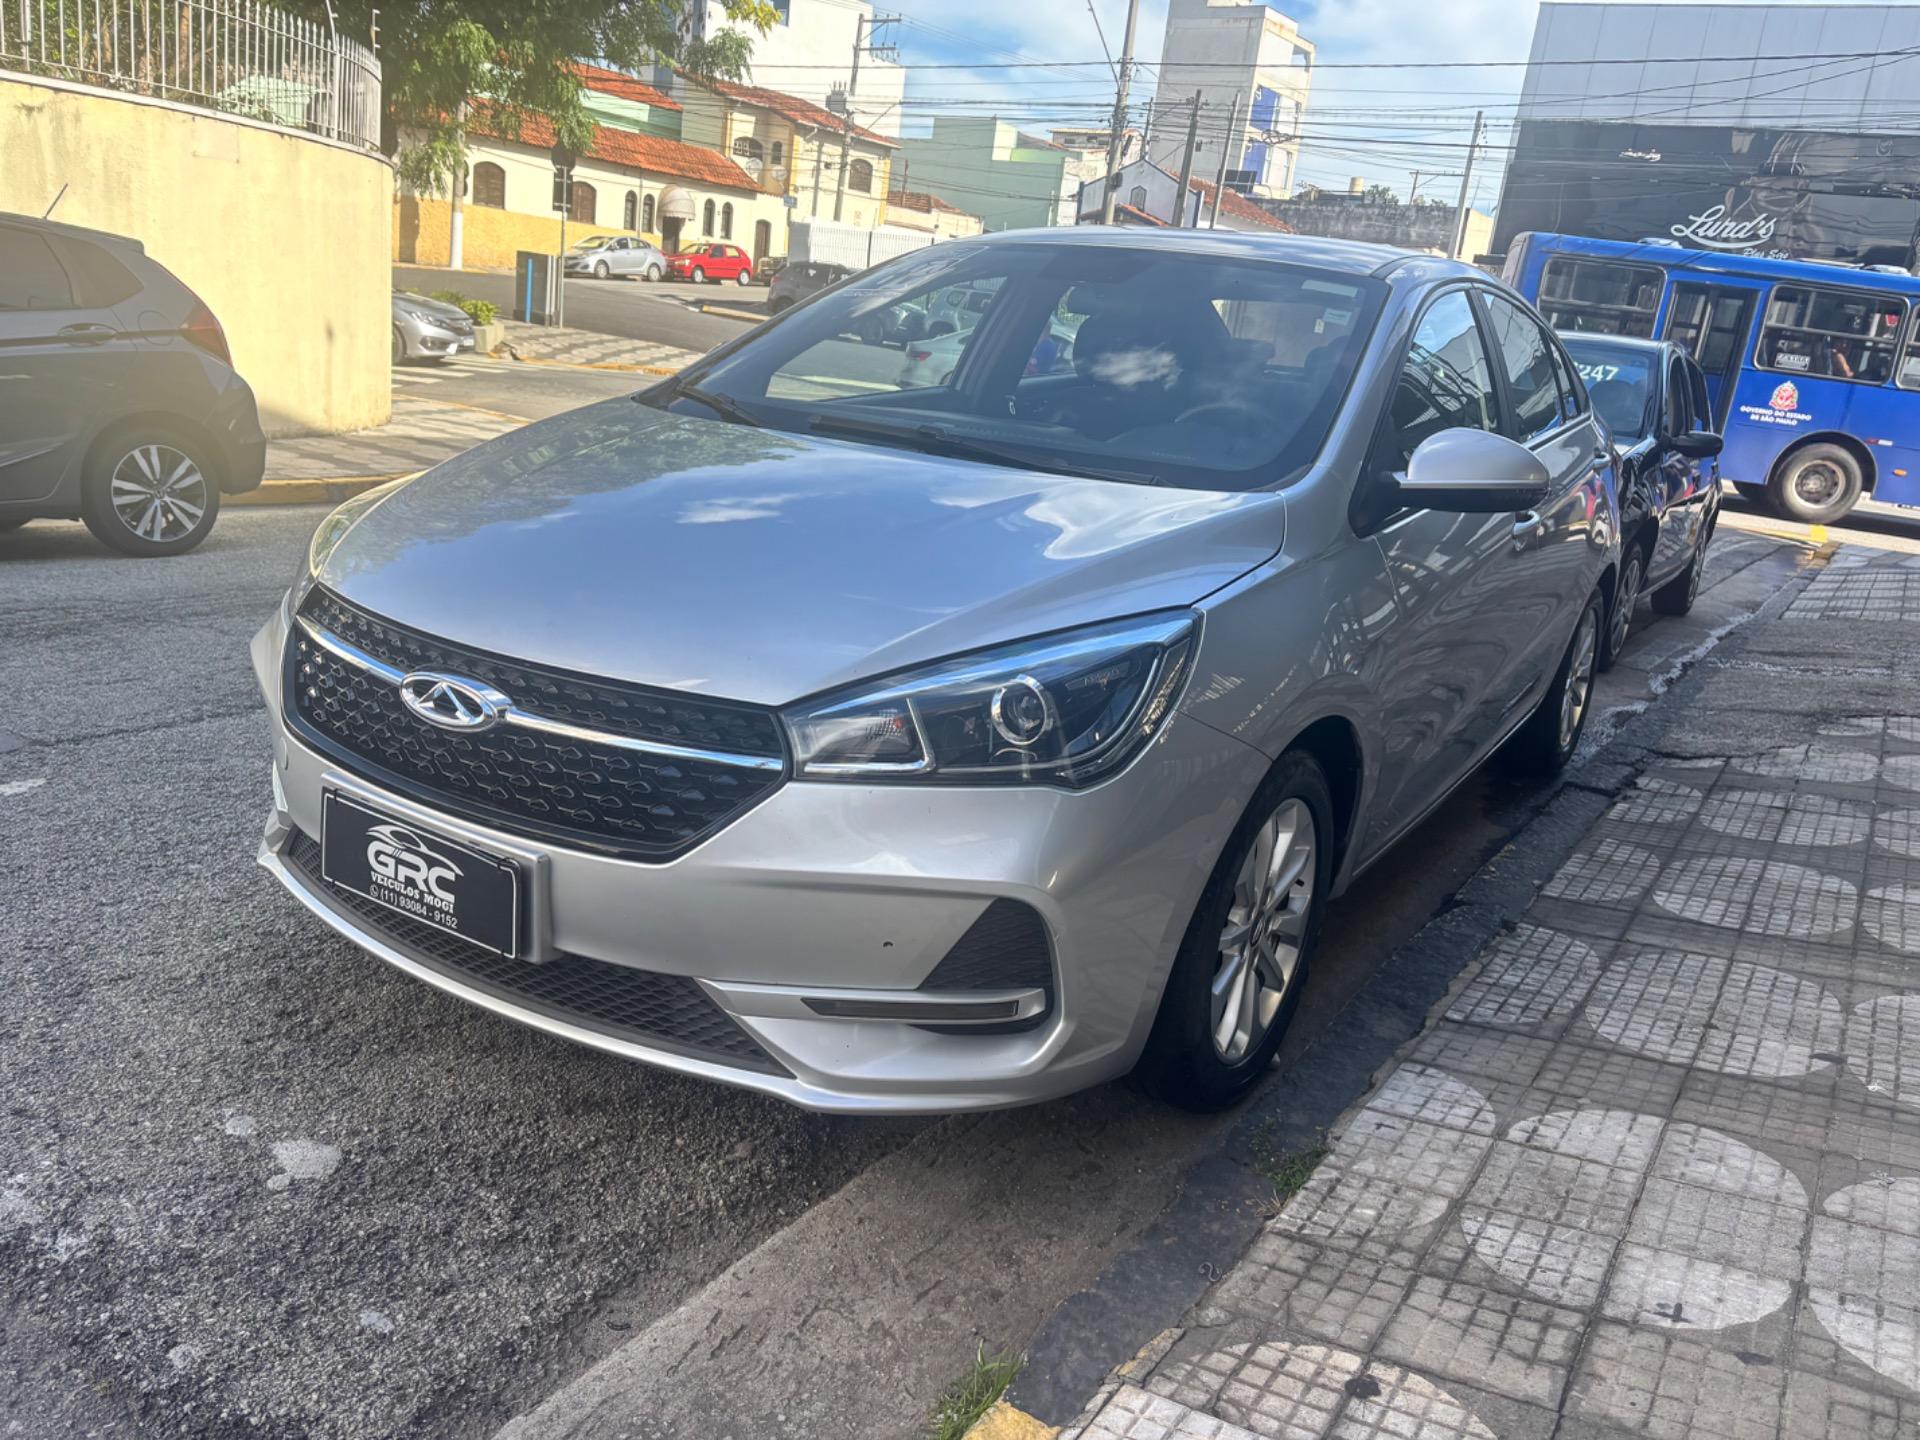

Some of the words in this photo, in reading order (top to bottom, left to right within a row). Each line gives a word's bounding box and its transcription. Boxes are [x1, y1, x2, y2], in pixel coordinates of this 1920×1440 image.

[1573, 361, 1619, 382] 247
[1740, 405, 1773, 415] GOVERNO
[1786, 411, 1812, 421] ESTADO
[1760, 414, 1774, 423] SÃO
[1775, 417, 1798, 426] PAULO
[366, 840, 455, 904] GRC
[370, 871, 420, 900] VEICULOS
[423, 893, 454, 914] MOGI
[381, 888, 398, 906] (11)
[399, 896, 427, 916] 93084
[433, 911, 458, 929] 9152
